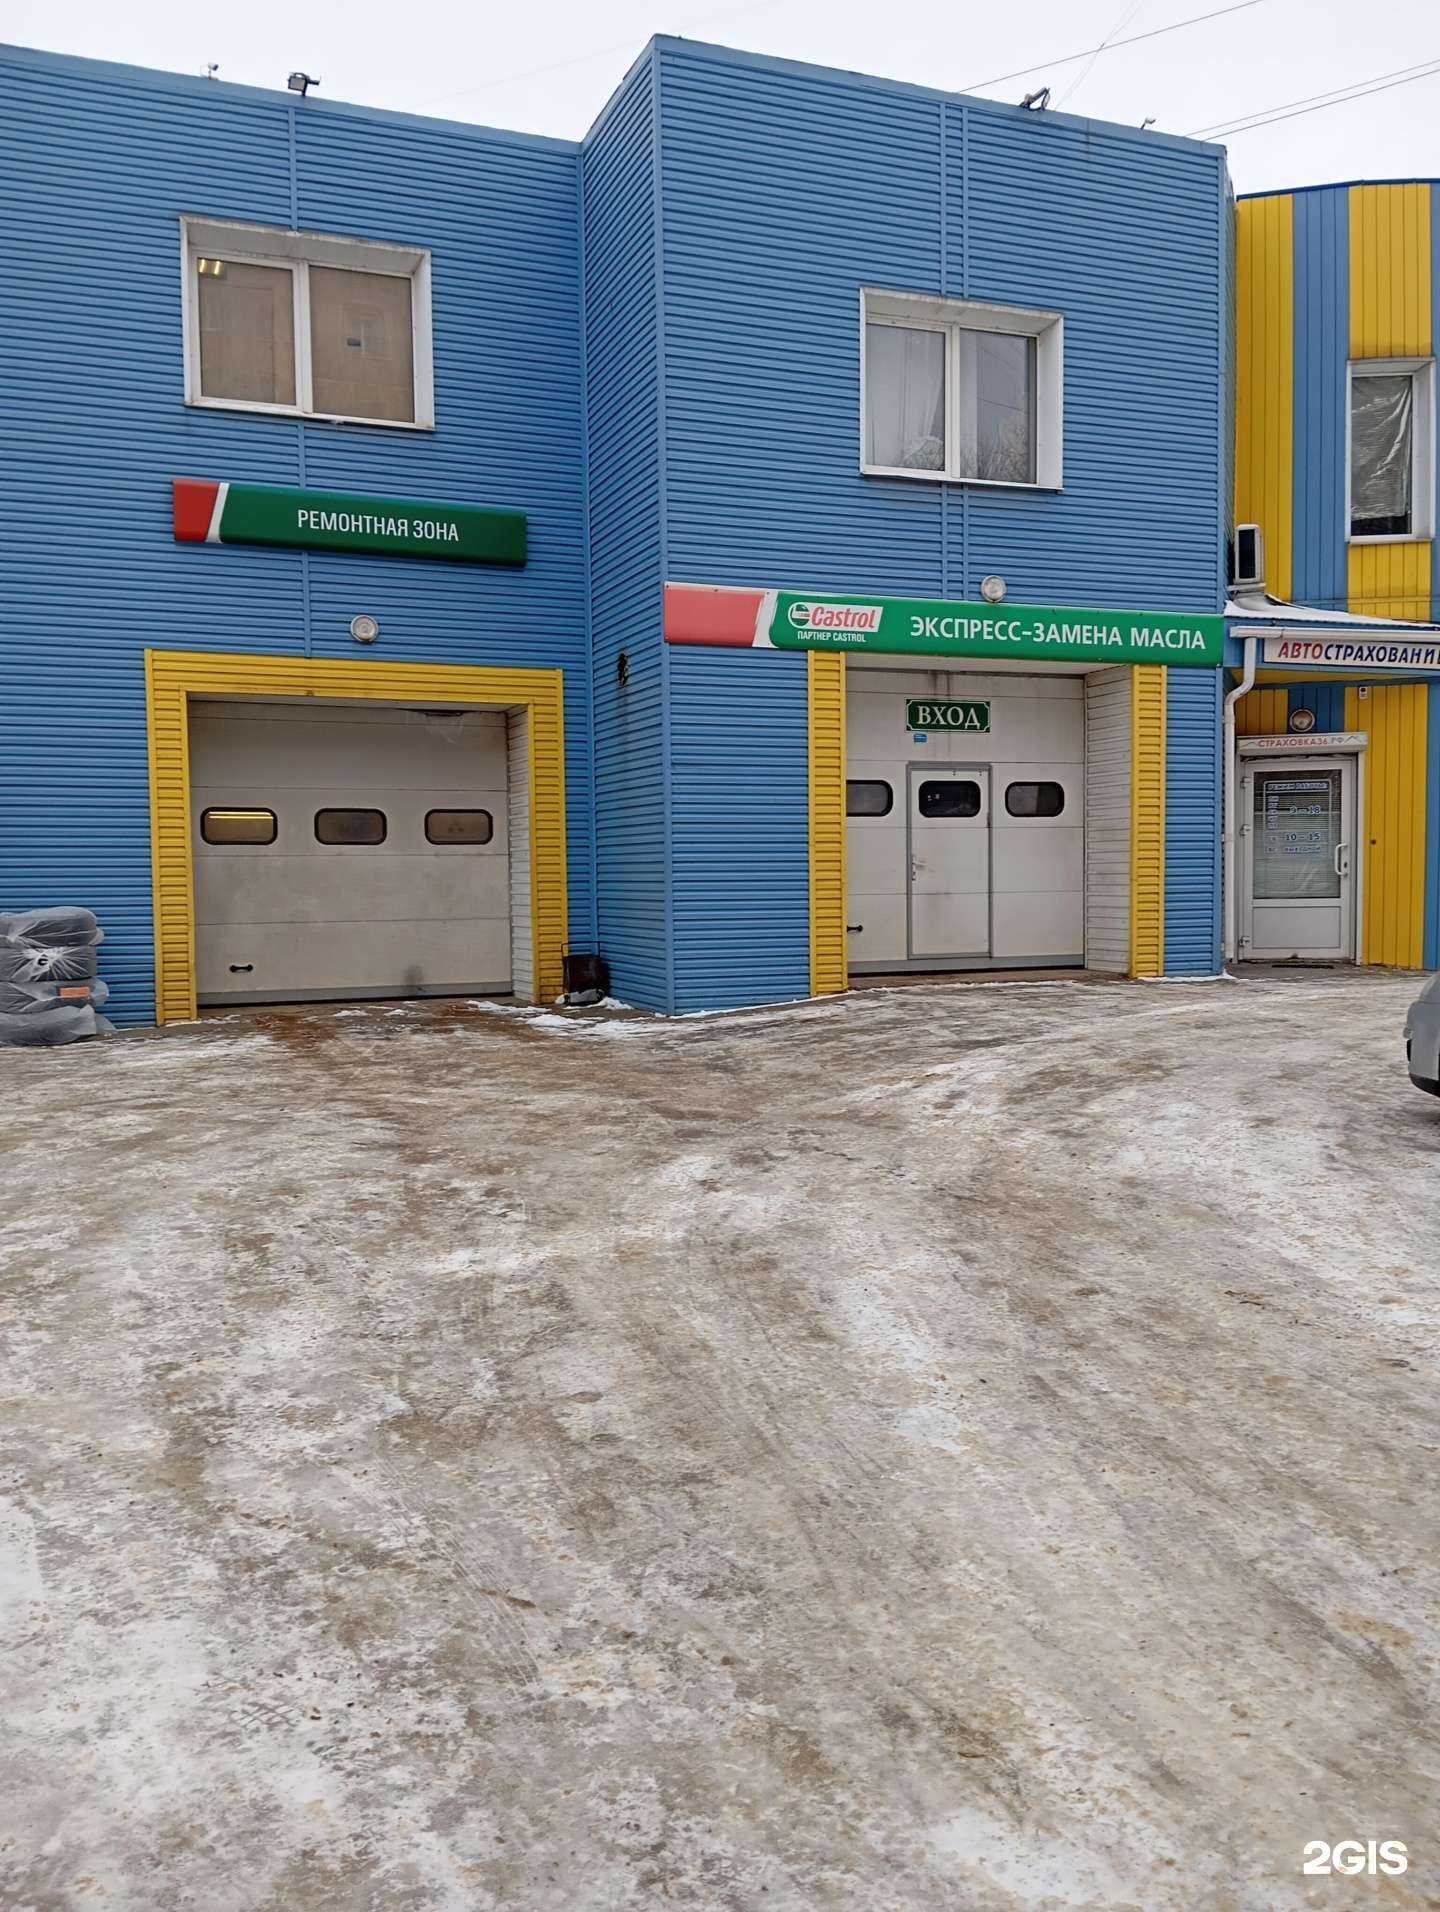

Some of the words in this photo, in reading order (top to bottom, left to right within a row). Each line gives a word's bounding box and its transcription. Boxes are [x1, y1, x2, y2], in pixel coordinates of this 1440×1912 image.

[297, 509, 409, 537] РЕМОНТНАЯ
[412, 519, 459, 542] ЗОНА
[811, 606, 876, 629] Castrol
[797, 630, 832, 641] ПАРТНЕР
[832, 632, 867, 643] CASTROL
[910, 615, 1123, 647] ЭКСПРЕСС-ЗАМЕНА
[1129, 626, 1206, 650] МАСЛА
[916, 705, 981, 730] ВХОД
